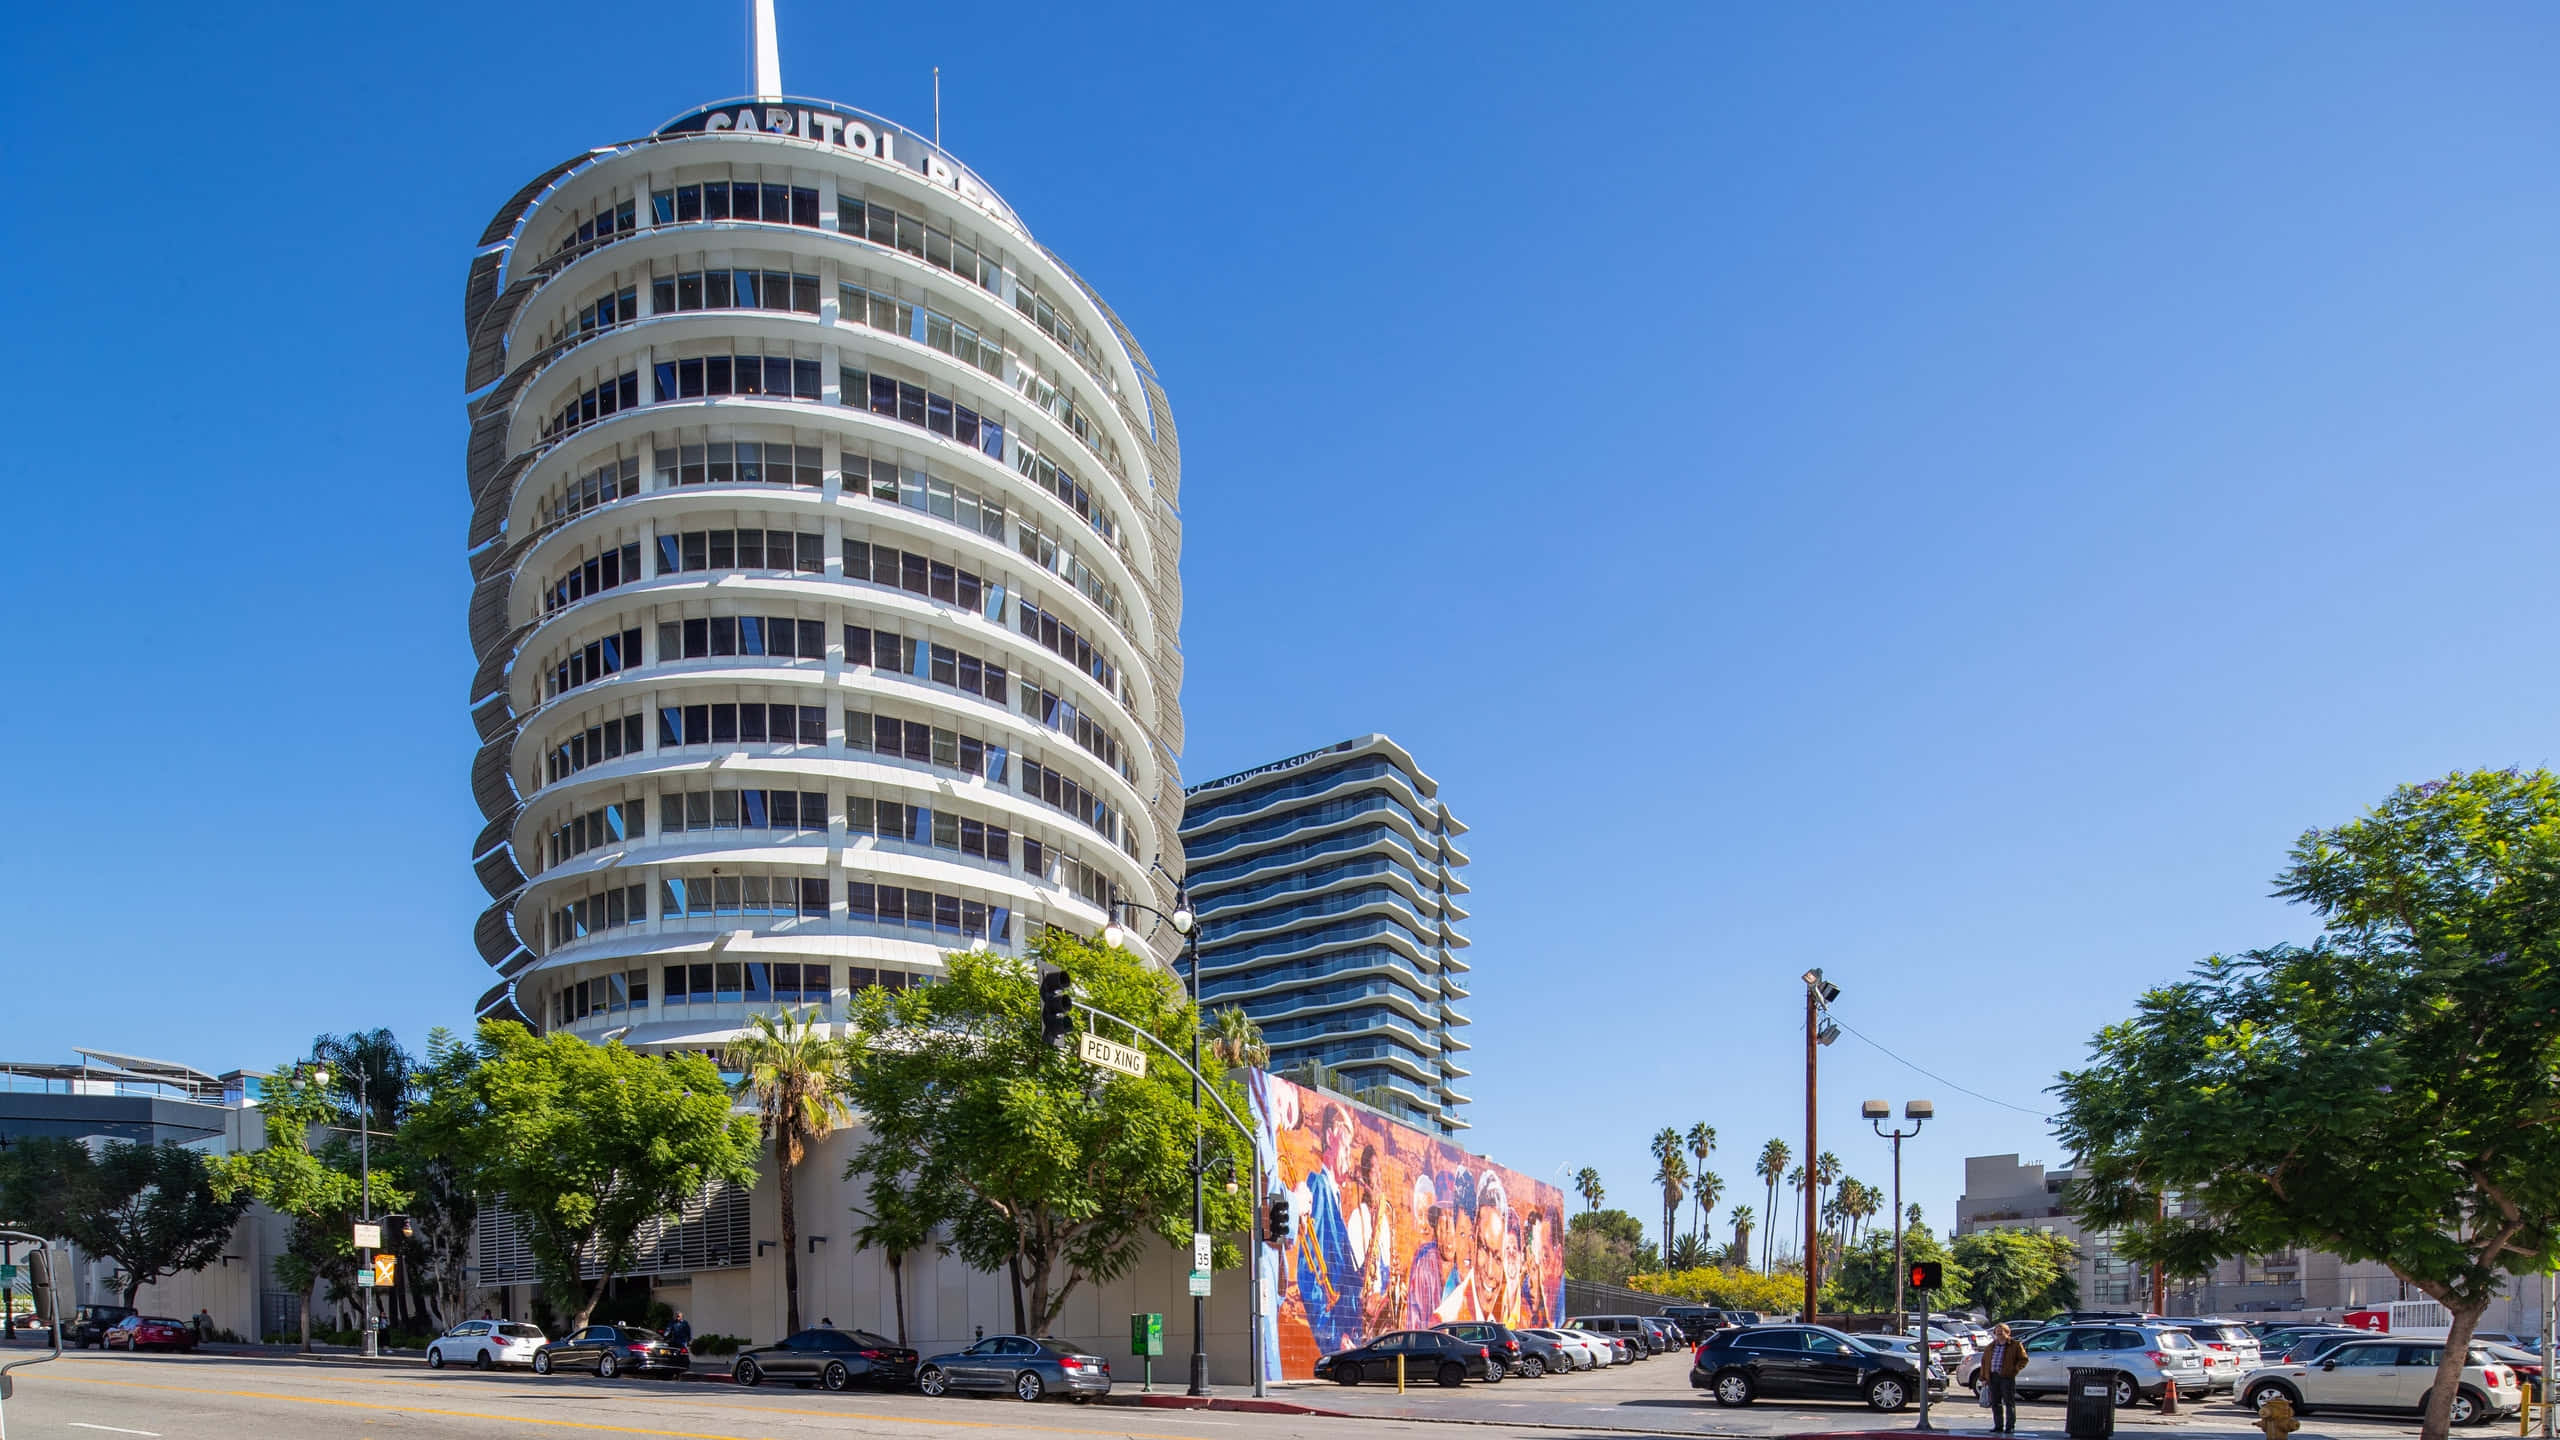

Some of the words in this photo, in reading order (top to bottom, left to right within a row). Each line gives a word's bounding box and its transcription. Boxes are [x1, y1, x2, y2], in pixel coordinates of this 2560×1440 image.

[705, 108, 906, 168] CAPITOL
[1088, 1040, 1111, 1061] PED
[1114, 1048, 1140, 1071] XING
[1197, 1252, 1209, 1266] 35
[2368, 1315, 2380, 1325] A
